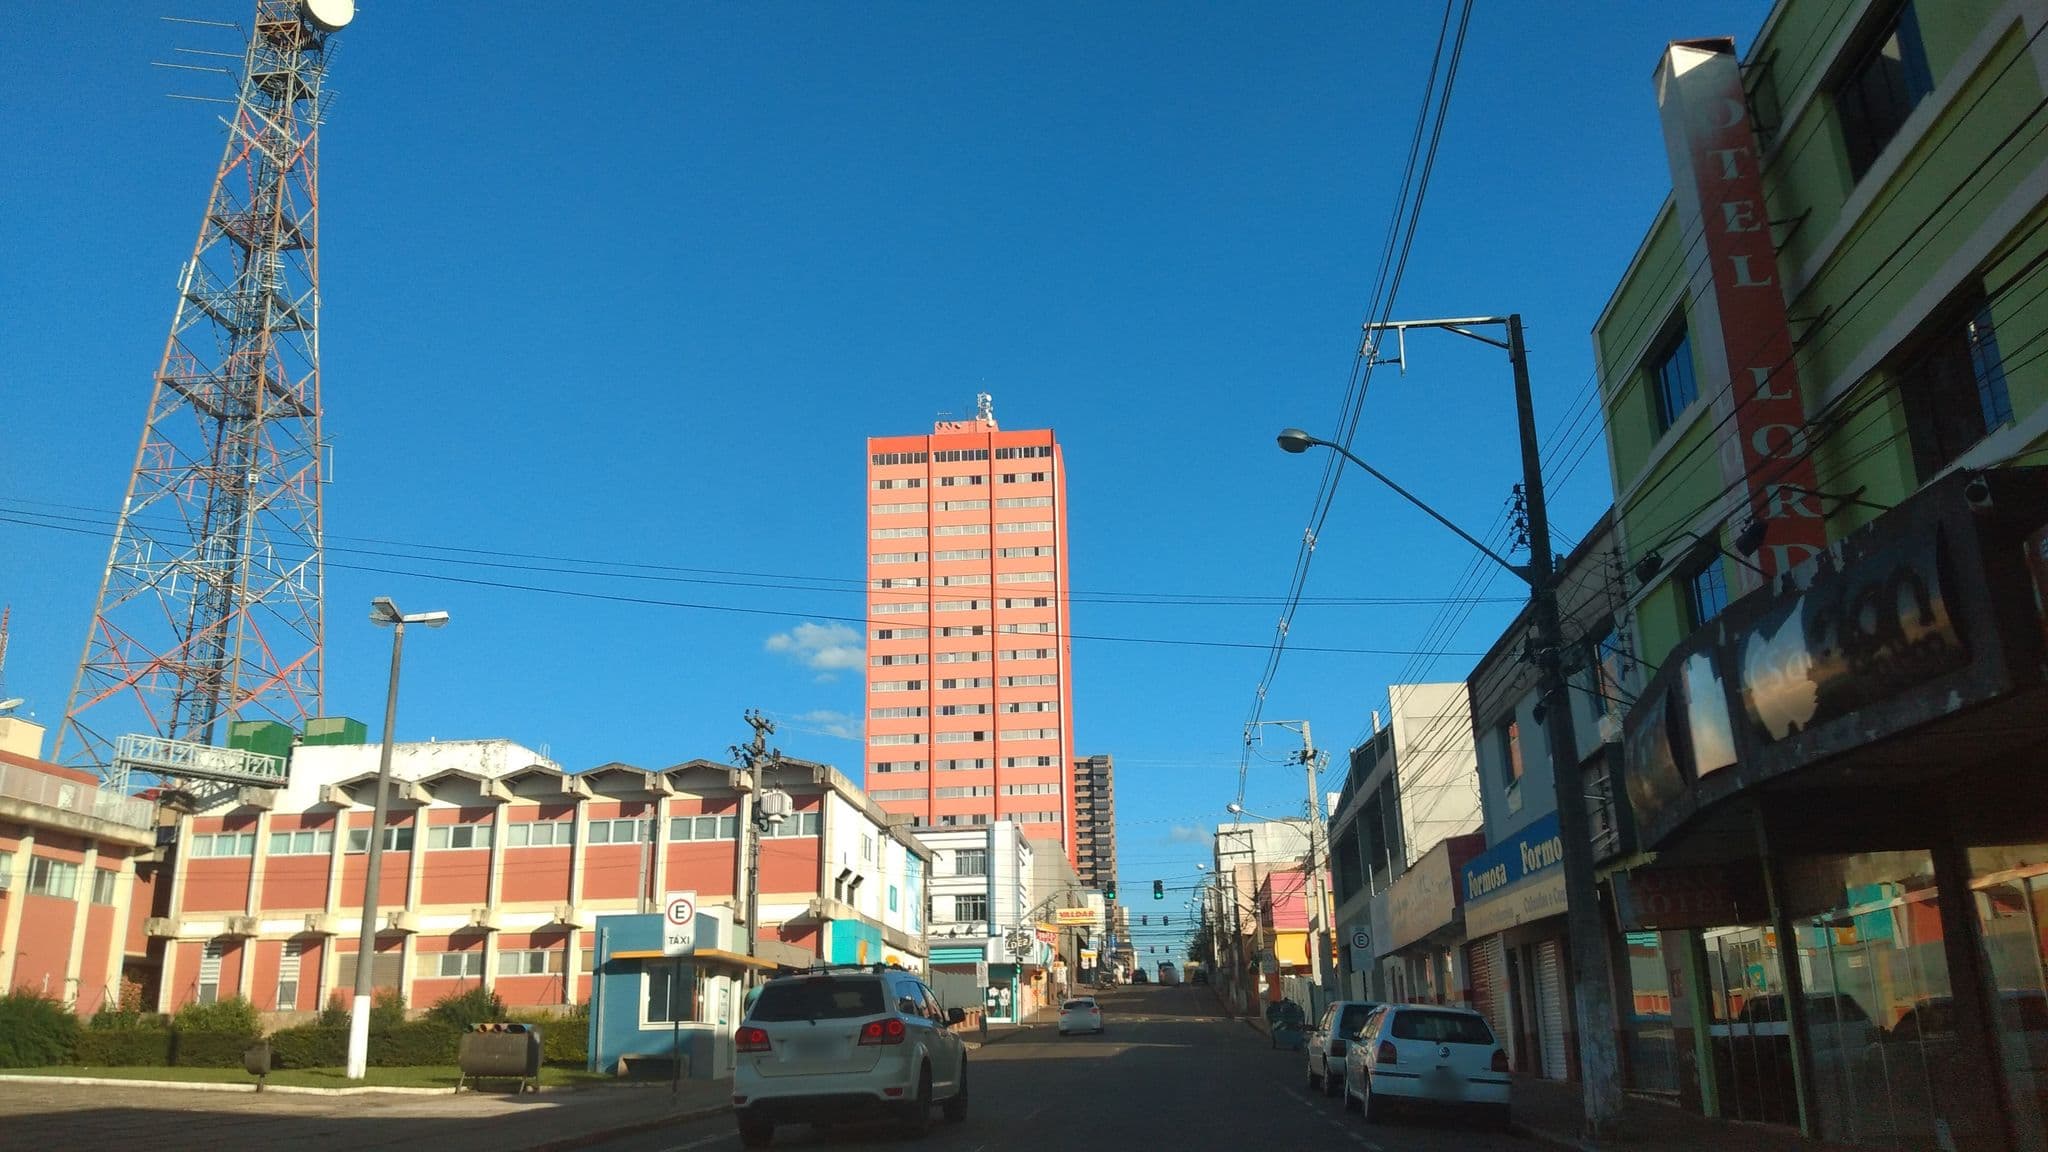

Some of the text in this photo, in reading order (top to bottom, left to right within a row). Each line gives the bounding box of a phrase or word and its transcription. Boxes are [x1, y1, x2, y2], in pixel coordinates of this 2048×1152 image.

[1705, 97, 1772, 288] OTEL
[1467, 863, 1508, 899] Formosa
[1519, 836, 1563, 875] Formo
[675, 904, 685, 919] E
[1357, 935, 1365, 946] E
